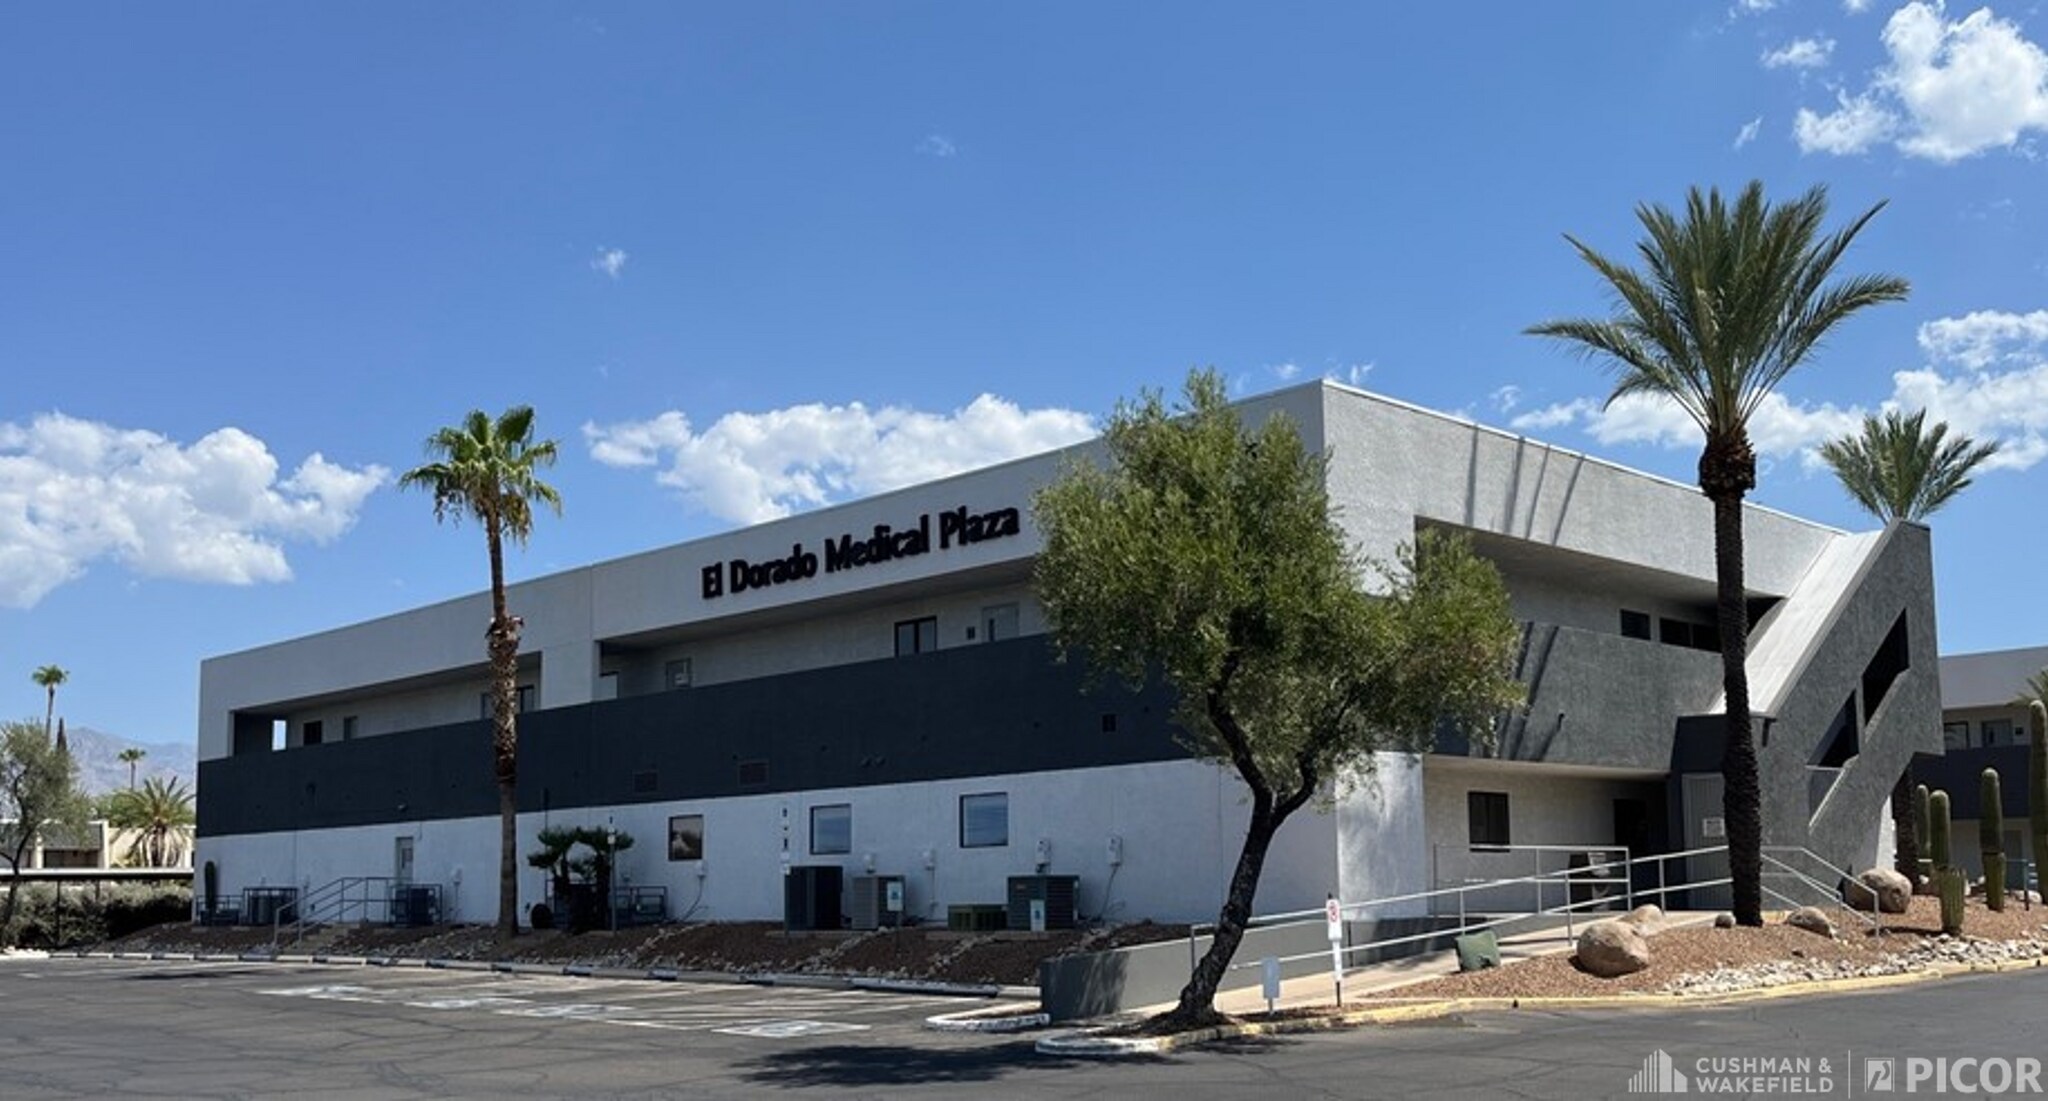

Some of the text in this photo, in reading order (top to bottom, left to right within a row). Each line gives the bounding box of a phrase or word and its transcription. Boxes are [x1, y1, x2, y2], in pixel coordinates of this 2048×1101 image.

[701, 505, 1020, 600] El Dorado Medical Plaza
